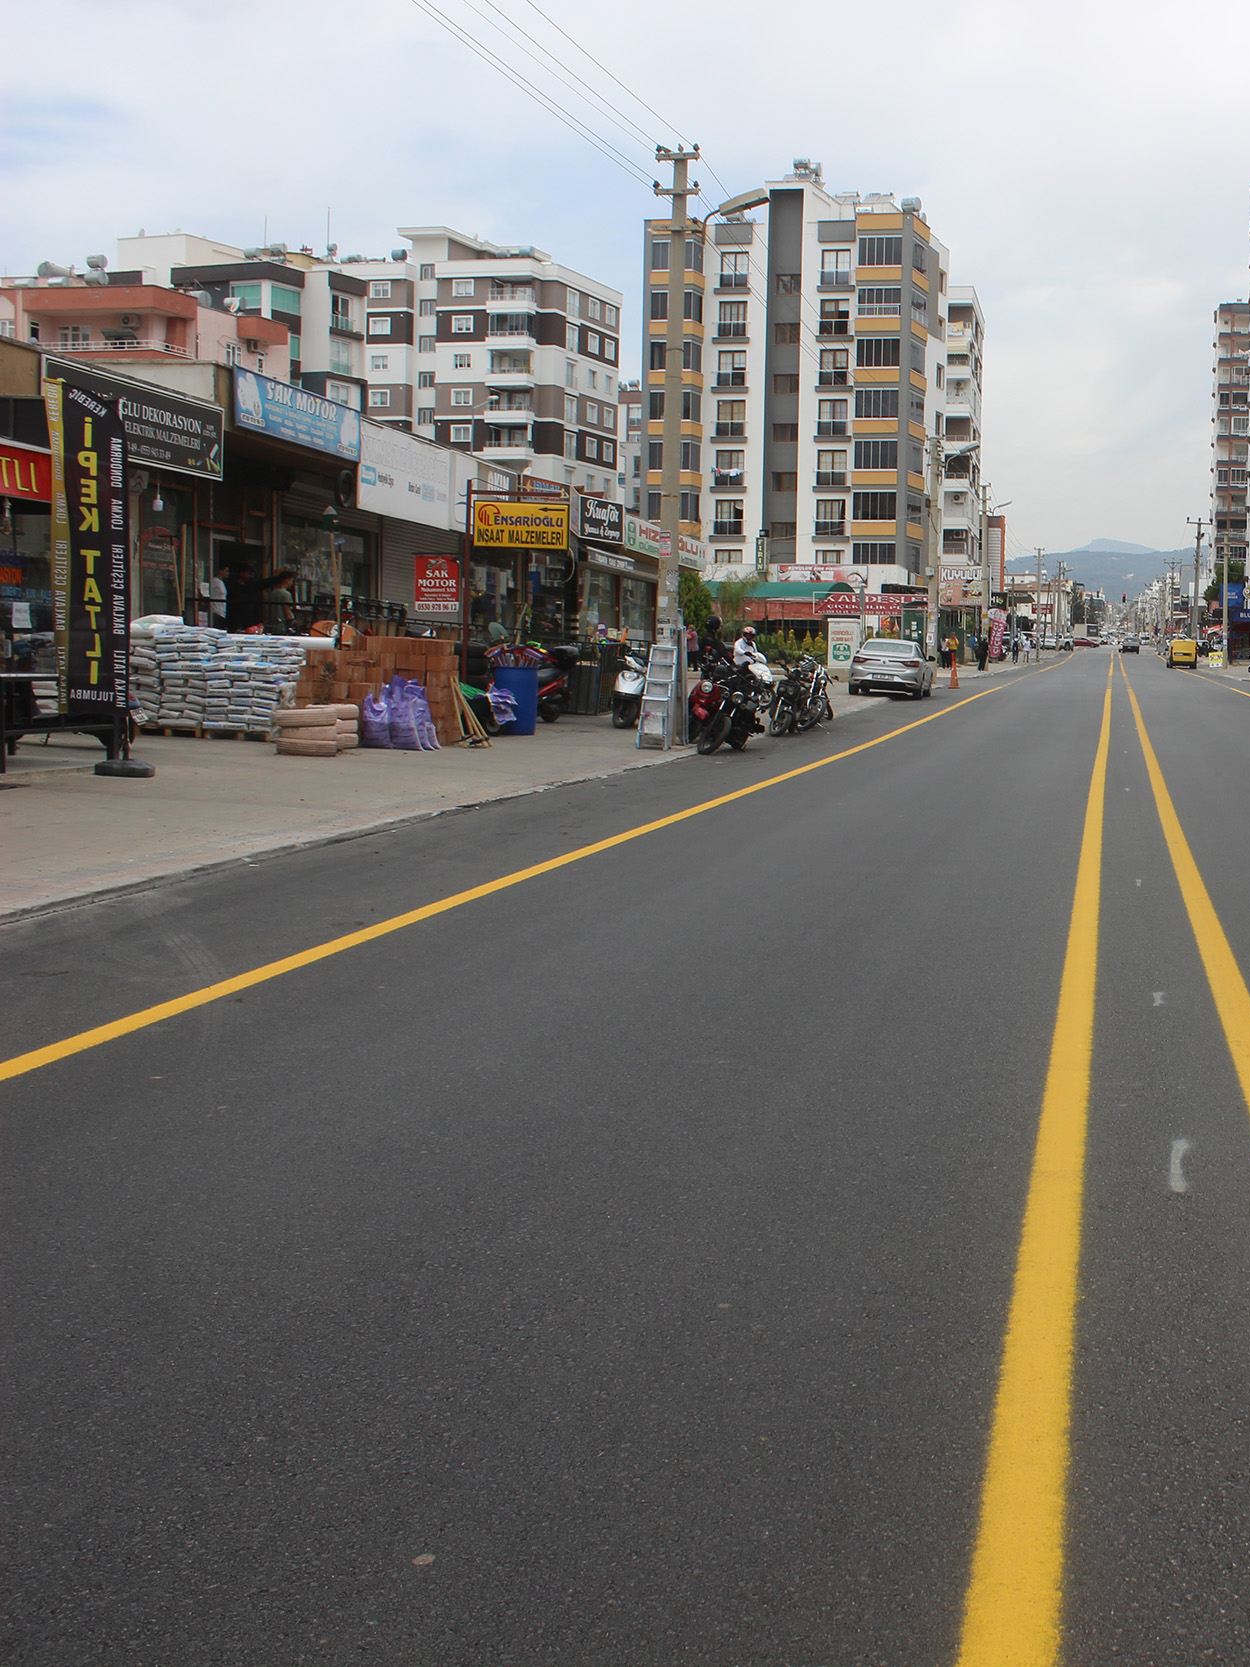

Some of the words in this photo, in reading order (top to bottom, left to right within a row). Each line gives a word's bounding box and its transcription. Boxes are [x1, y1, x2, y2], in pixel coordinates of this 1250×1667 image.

[296, 391, 337, 423] MOTOR
[142, 402, 202, 435] DEKORASYON
[125, 420, 155, 439] ELEKTRİK
[155, 427, 201, 451] MALZEMELERİ
[494, 514, 563, 528] ENSARİOĞLU
[477, 526, 504, 544] İNŞAAT
[508, 529, 564, 546] MALZEMELERİ
[417, 579, 457, 587] MOTOR
[425, 569, 449, 578] SAK
